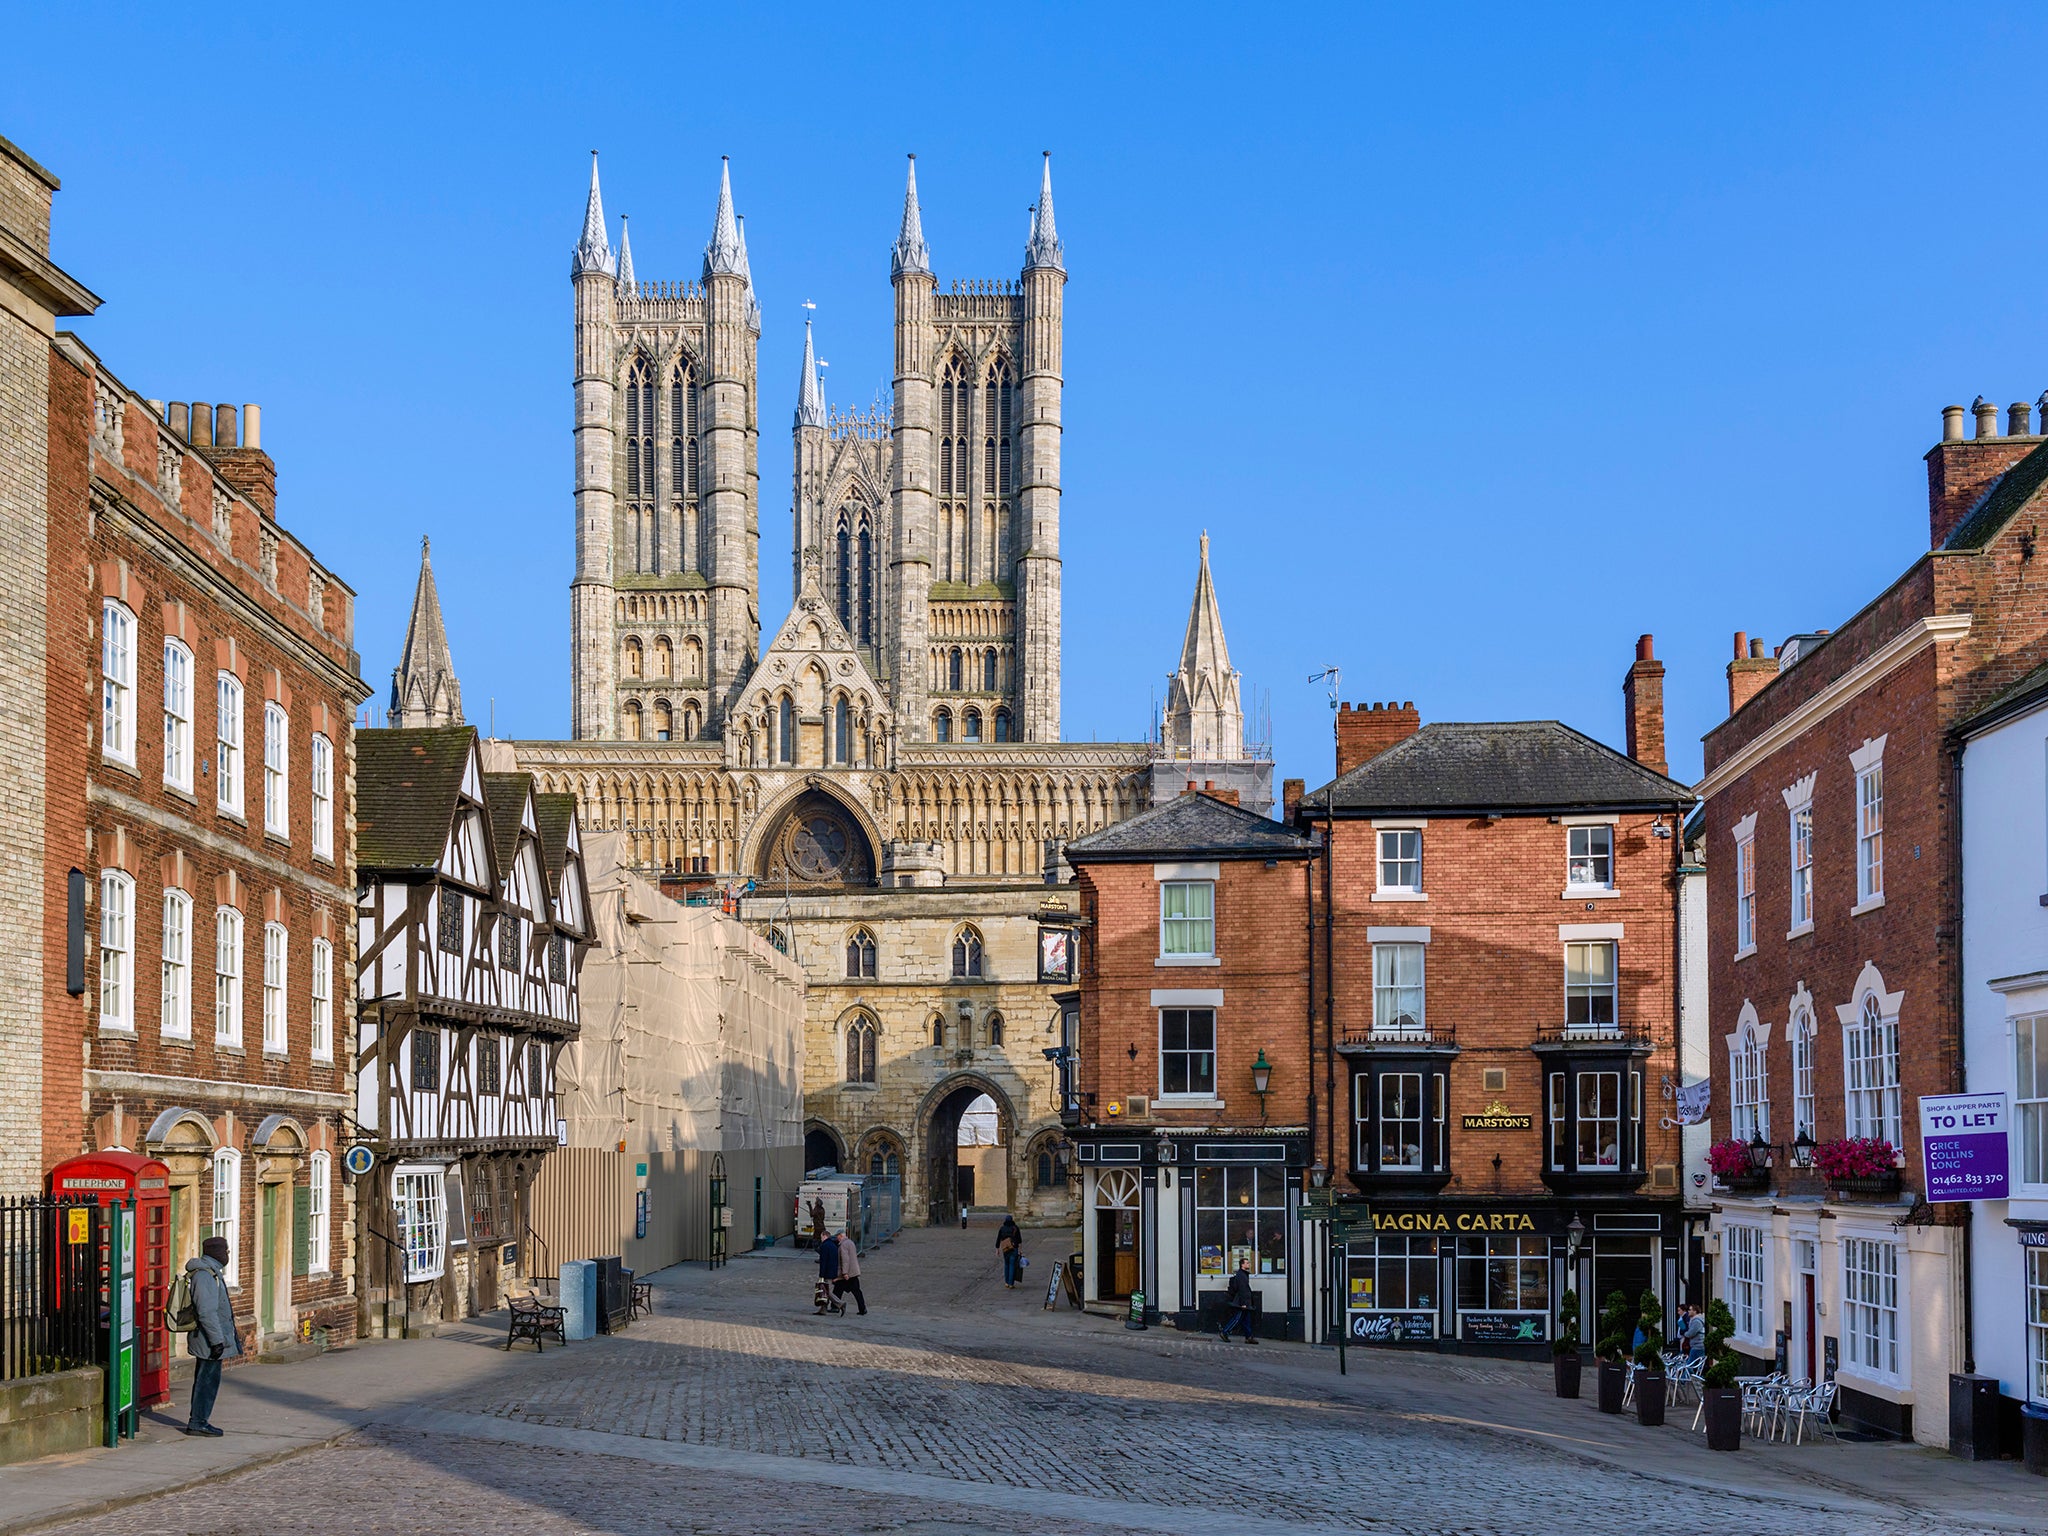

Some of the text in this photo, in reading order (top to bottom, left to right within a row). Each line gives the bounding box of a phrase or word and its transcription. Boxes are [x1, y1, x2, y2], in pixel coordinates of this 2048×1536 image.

[1040, 903, 1067, 911] MARSTON'S
[1464, 1118, 1530, 1128] MARSTON'S
[1930, 1113, 1998, 1129] TO LET
[1930, 1141, 1960, 1150] GRICE
[1930, 1150, 1974, 1160] COLLINS
[1931, 1160, 1961, 1170] LONG
[66, 1179, 124, 1188] TELEPHONE
[1932, 1173, 2004, 1185] 01462 833 370
[1456, 1214, 1535, 1230] CARTA
[1354, 1315, 1392, 1337] Quiz
